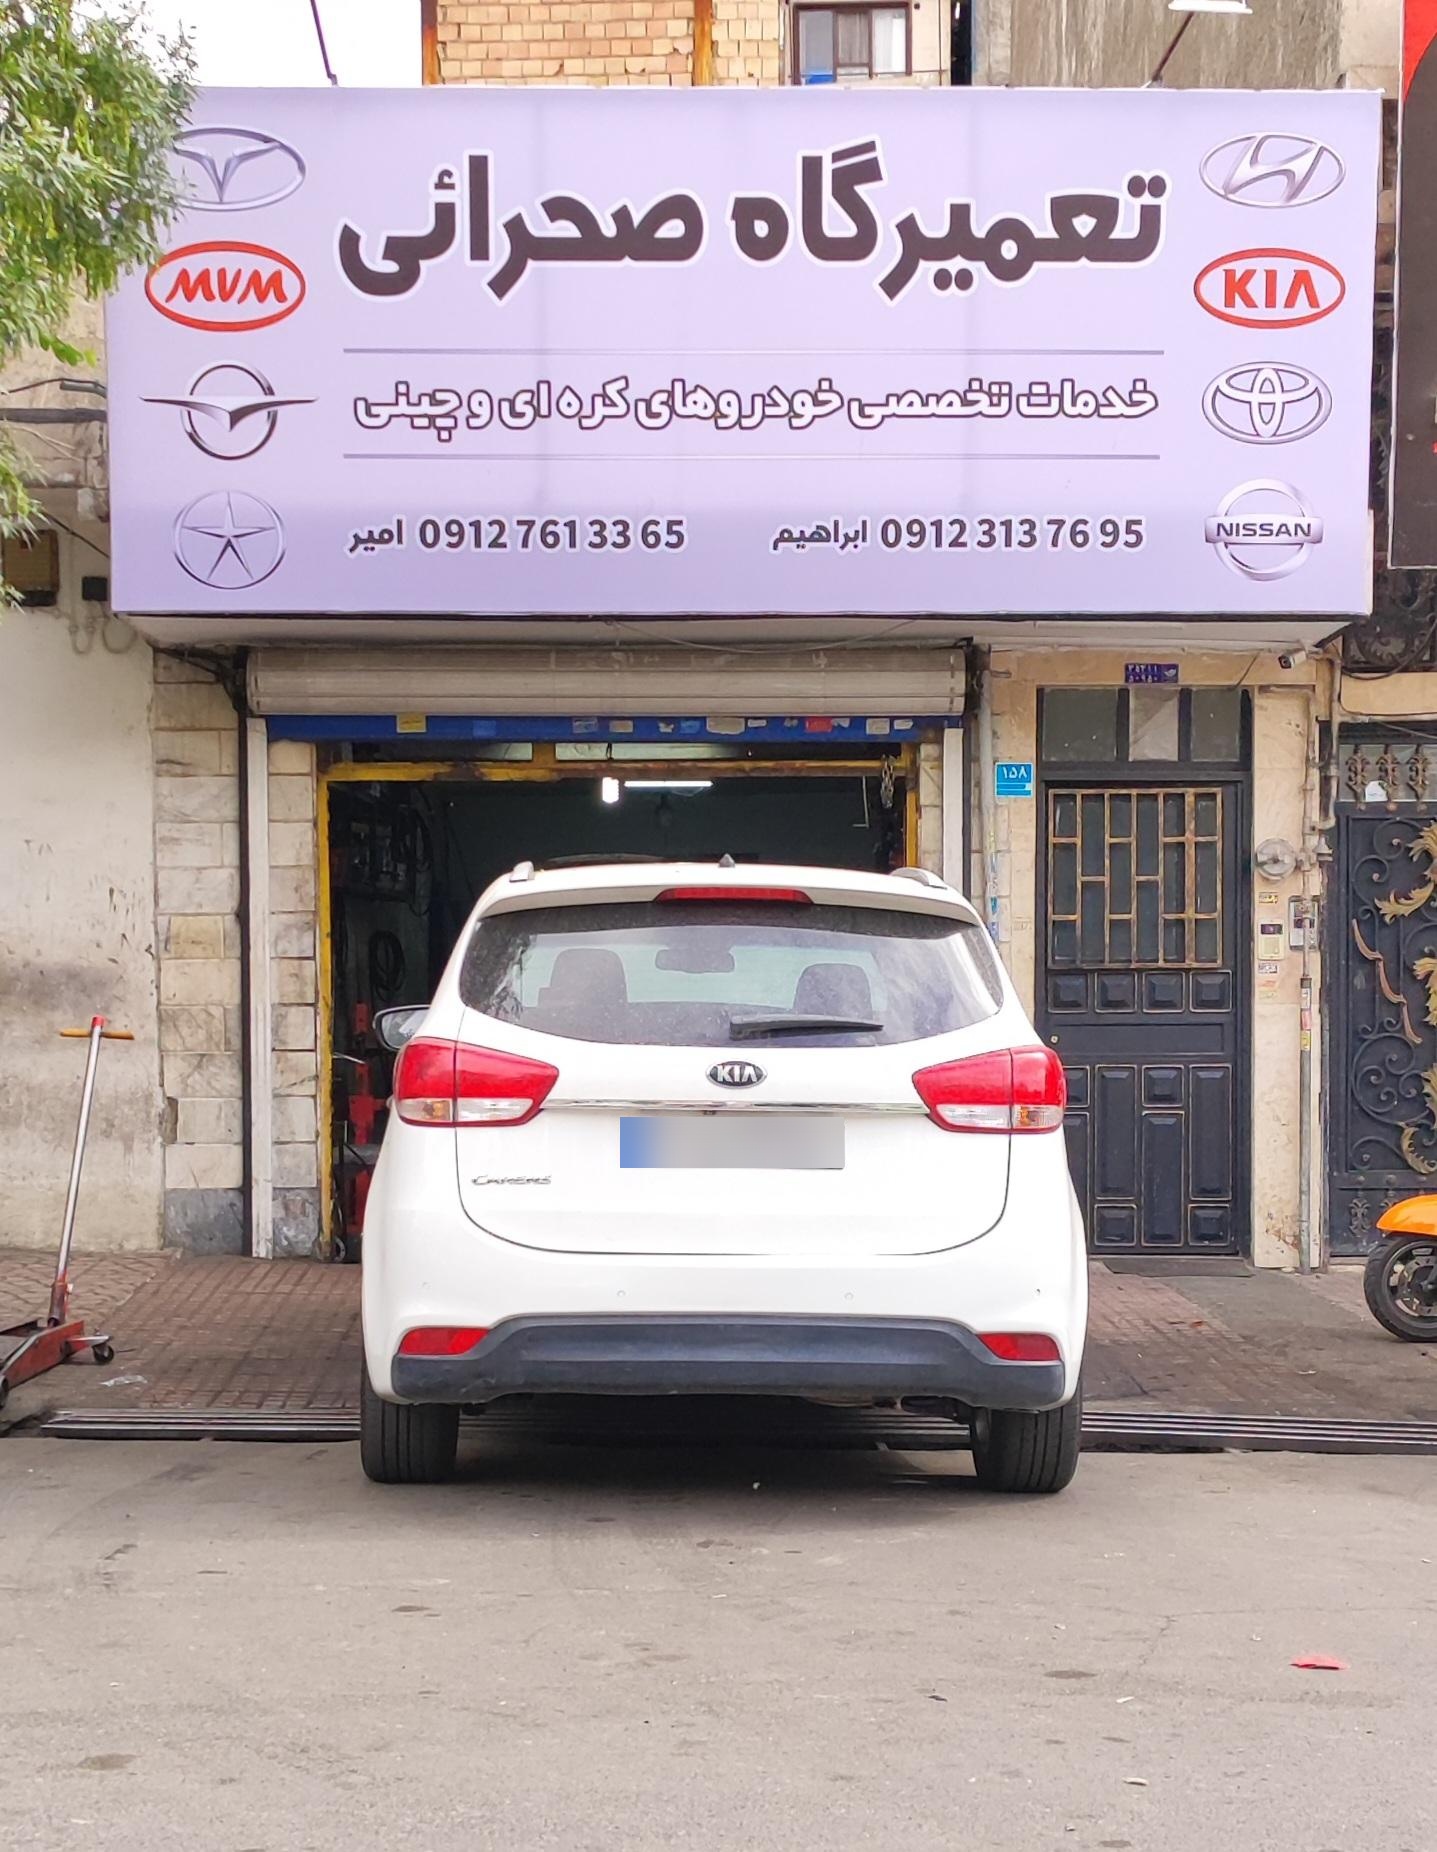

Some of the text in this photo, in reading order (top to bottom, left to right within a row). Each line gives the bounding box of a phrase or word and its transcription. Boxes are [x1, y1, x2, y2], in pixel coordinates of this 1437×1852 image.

[339, 141, 1165, 299] تعمیرگاه صحرائی
[165, 268, 289, 304] MVM
[1223, 268, 1321, 309] KIA
[354, 381, 463, 443] چینی
[466, 389, 493, 430] و
[556, 376, 630, 430] کره
[847, 378, 1012, 430] تخصصی
[1016, 379, 1158, 418] خدمات
[349, 519, 403, 553] امیر
[773, 520, 866, 550] ابراهیم
[1216, 520, 1312, 541] NISSAN
[1002, 766, 1028, 779] ۱۵۸
[717, 1065, 757, 1082] KIA
